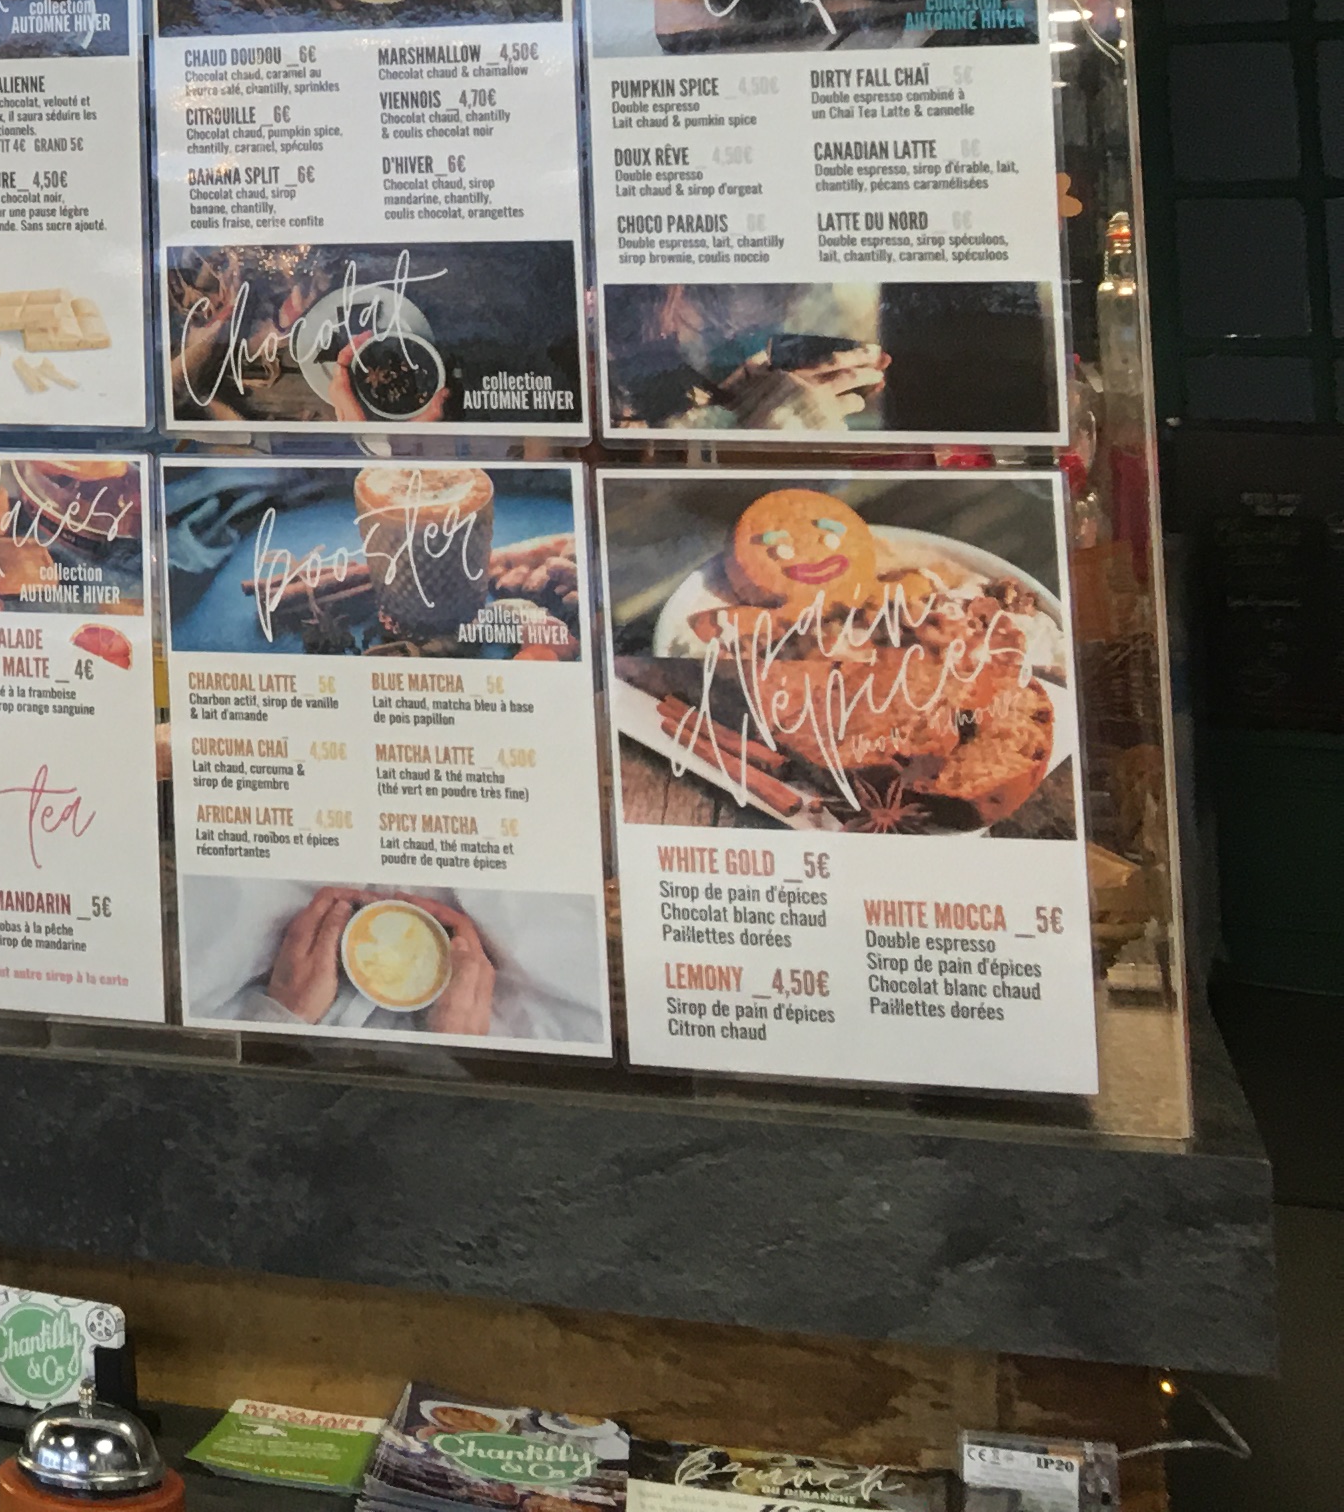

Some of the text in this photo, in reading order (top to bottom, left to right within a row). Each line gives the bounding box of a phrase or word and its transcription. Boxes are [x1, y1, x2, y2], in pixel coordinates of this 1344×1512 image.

[378, 44, 482, 66] MARSHMALLOW
[810, 63, 930, 88] DIRTY FALL CHAÏ
[611, 78, 719, 99] PUMPKIN SPICE
[80, 96, 90, 107] et
[814, 140, 937, 161] CANADIAN LATTE
[180, 248, 449, 407] Chocolat
[482, 372, 552, 390] collection
[463, 390, 574, 410] AUTOMNE HIVER
[3, 656, 50, 679] MALTE
[188, 672, 297, 693] CHARCOAL LATTE
[197, 806, 294, 827] AFRICAN LATTE
[658, 846, 775, 877] WHITE GOLD
[864, 900, 1006, 932] WHITE MOCCA
[662, 925, 792, 948] Paillettes dorées
[27, 1355, 64, 1385] & Co
[434, 1435, 602, 1477] Chantilly
[1035, 1457, 1075, 1473] IP20
